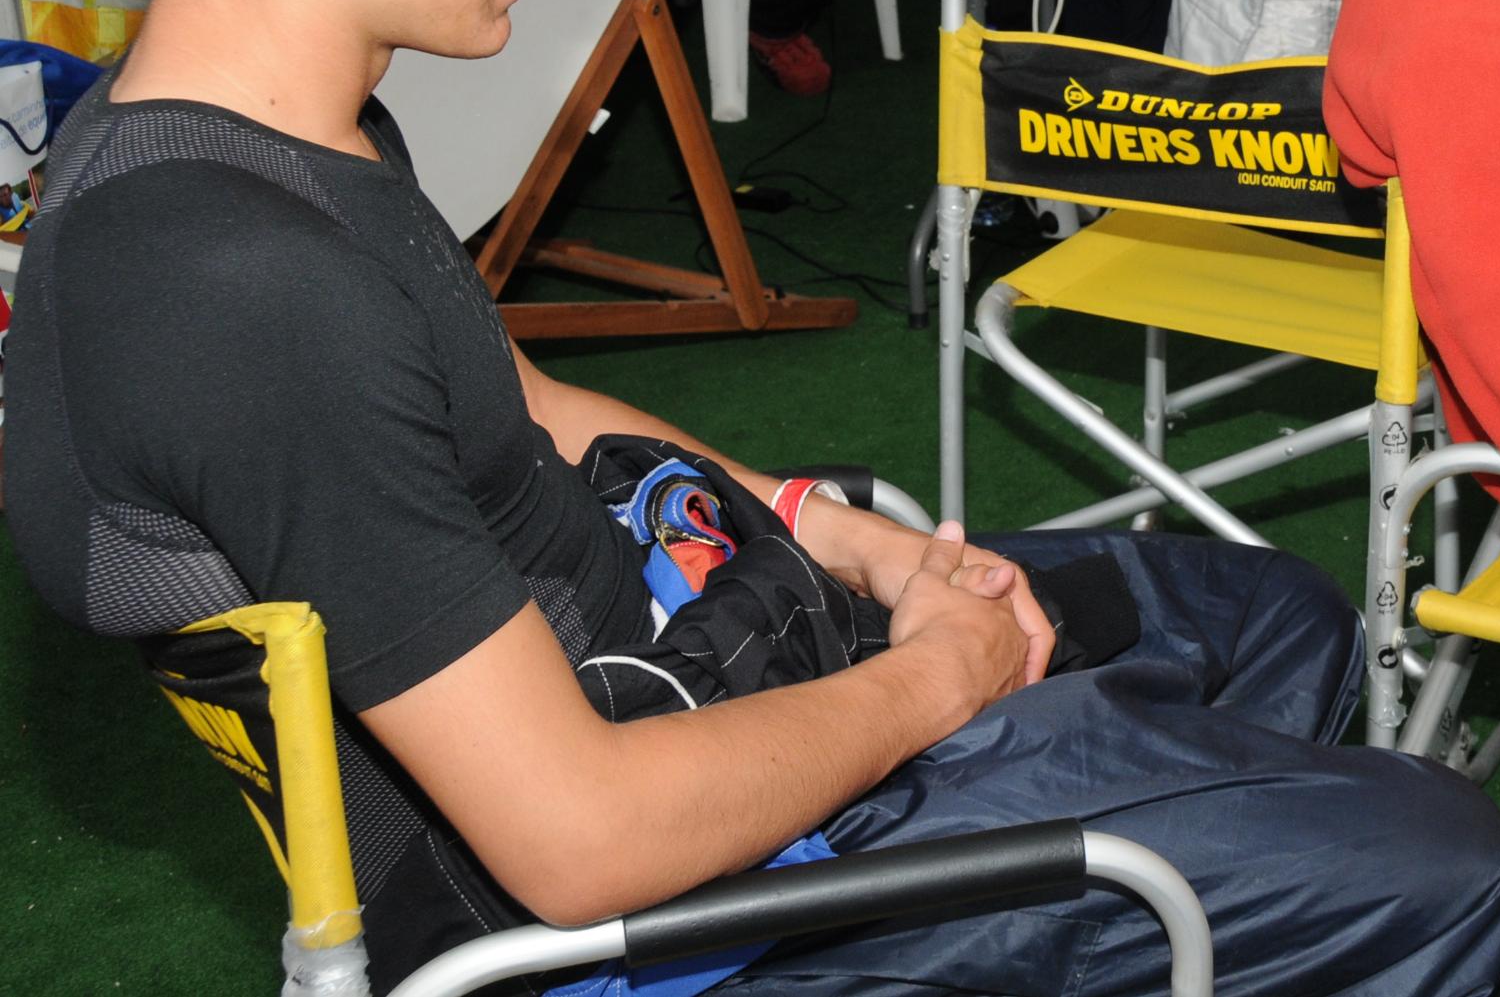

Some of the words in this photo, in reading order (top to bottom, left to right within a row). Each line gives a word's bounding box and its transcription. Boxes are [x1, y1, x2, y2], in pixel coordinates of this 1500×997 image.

[1096, 89, 1281, 122] DUNLOP
[1018, 108, 1201, 166] DRIVERS
[1208, 128, 1340, 178] KNOW
[1237, 172, 1261, 186] (QUI
[1261, 174, 1308, 191] CONDUIT
[1309, 178, 1336, 194] SAIT)
